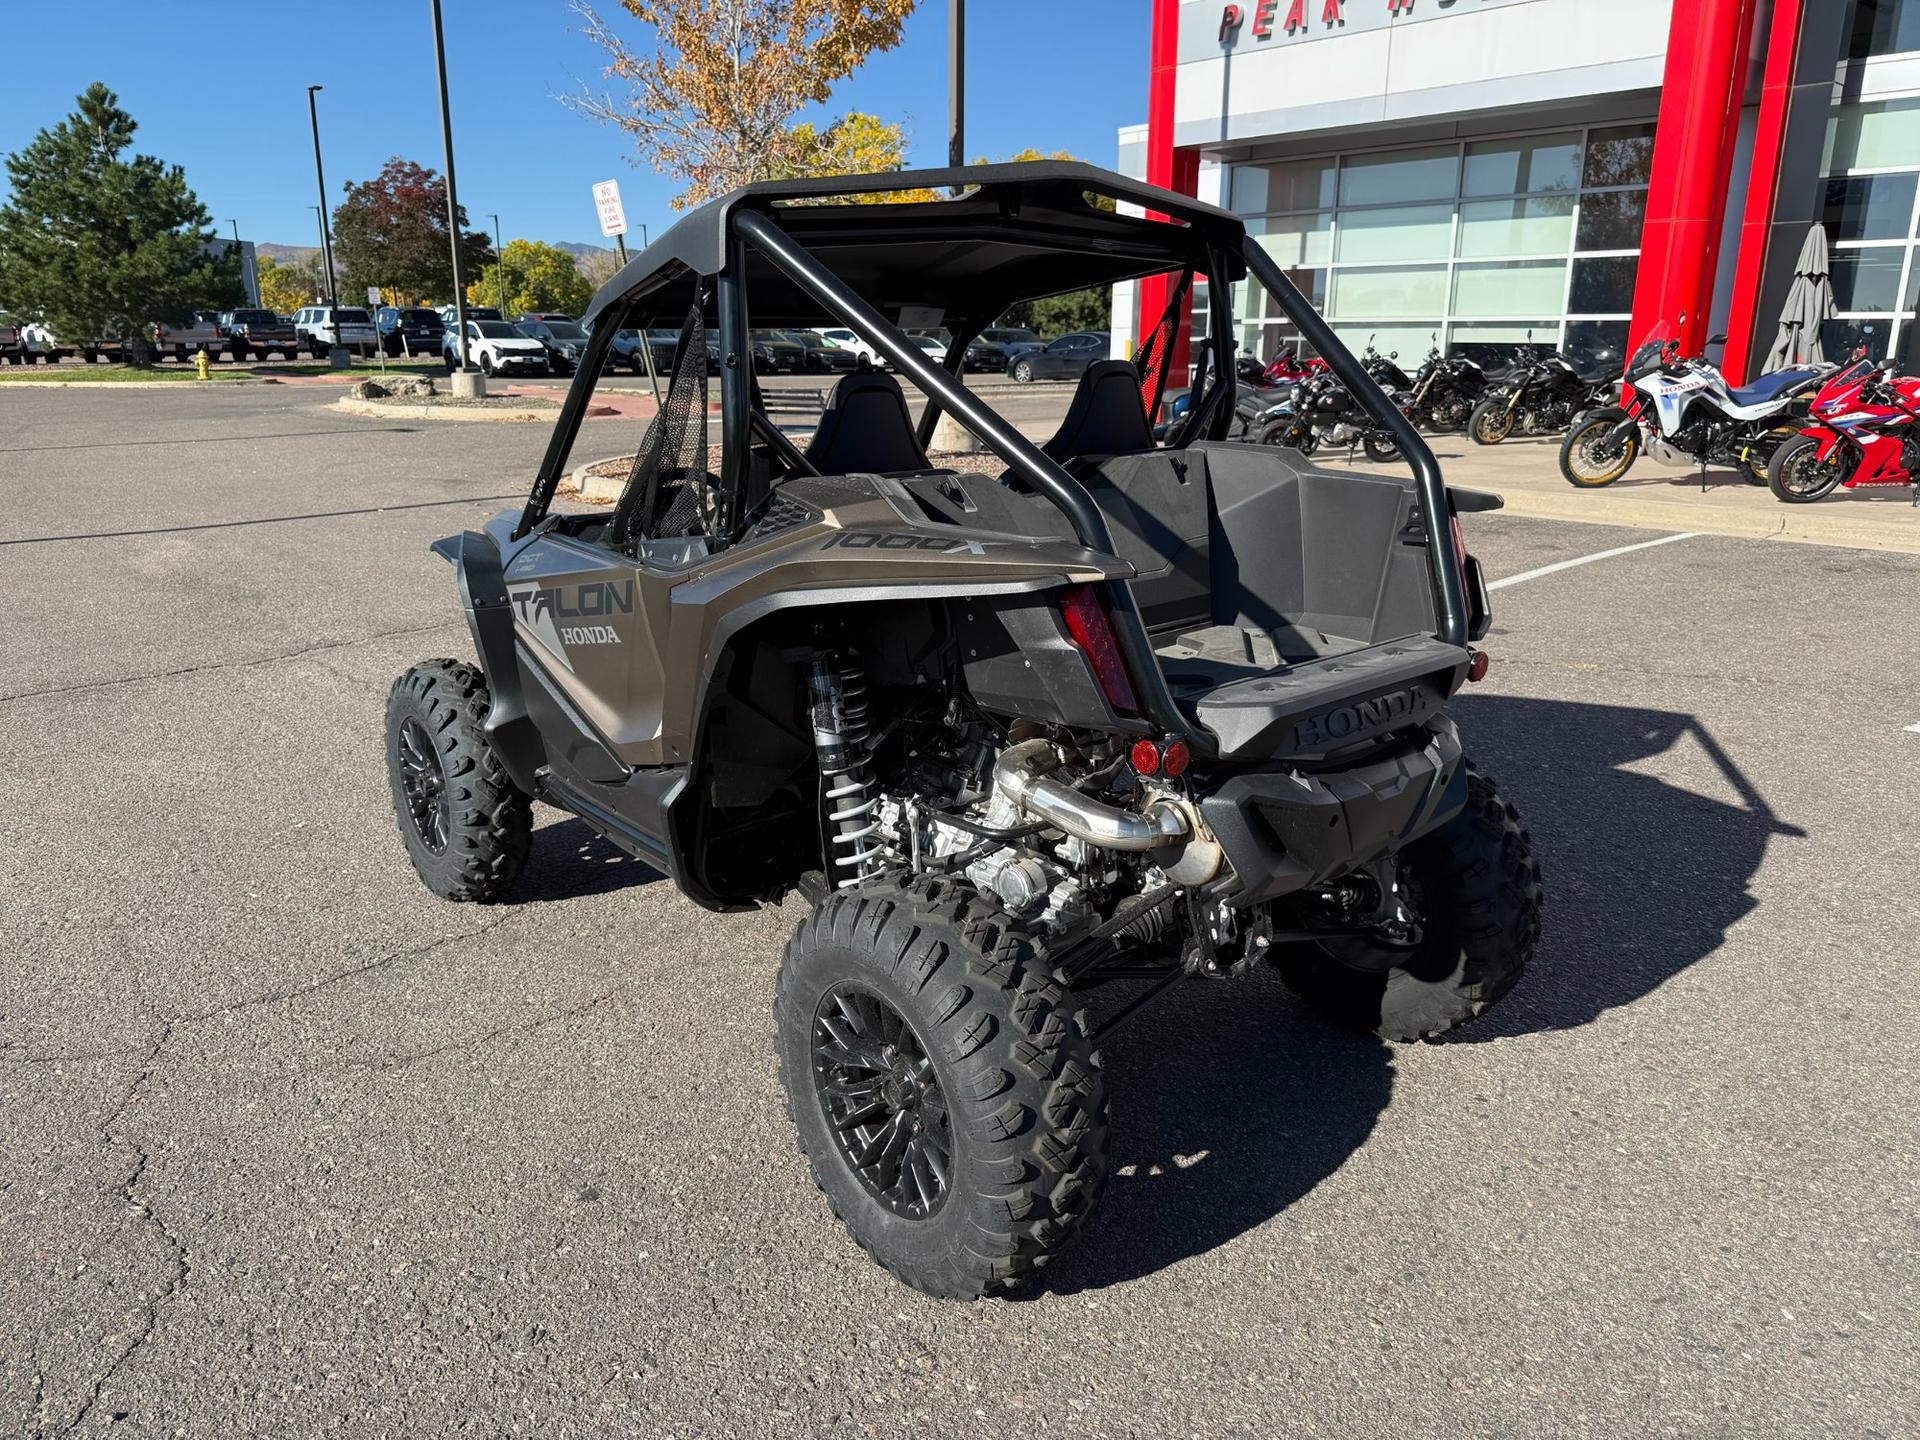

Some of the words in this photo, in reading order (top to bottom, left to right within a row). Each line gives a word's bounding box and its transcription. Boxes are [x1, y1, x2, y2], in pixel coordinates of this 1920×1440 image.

[1219, 0, 1345, 43] PEAK
[1660, 381, 1702, 395] HONDA
[821, 533, 985, 555] 1000X
[512, 579, 634, 625] TALON
[560, 625, 622, 645] HONDA
[1294, 684, 1427, 751] HONDA
